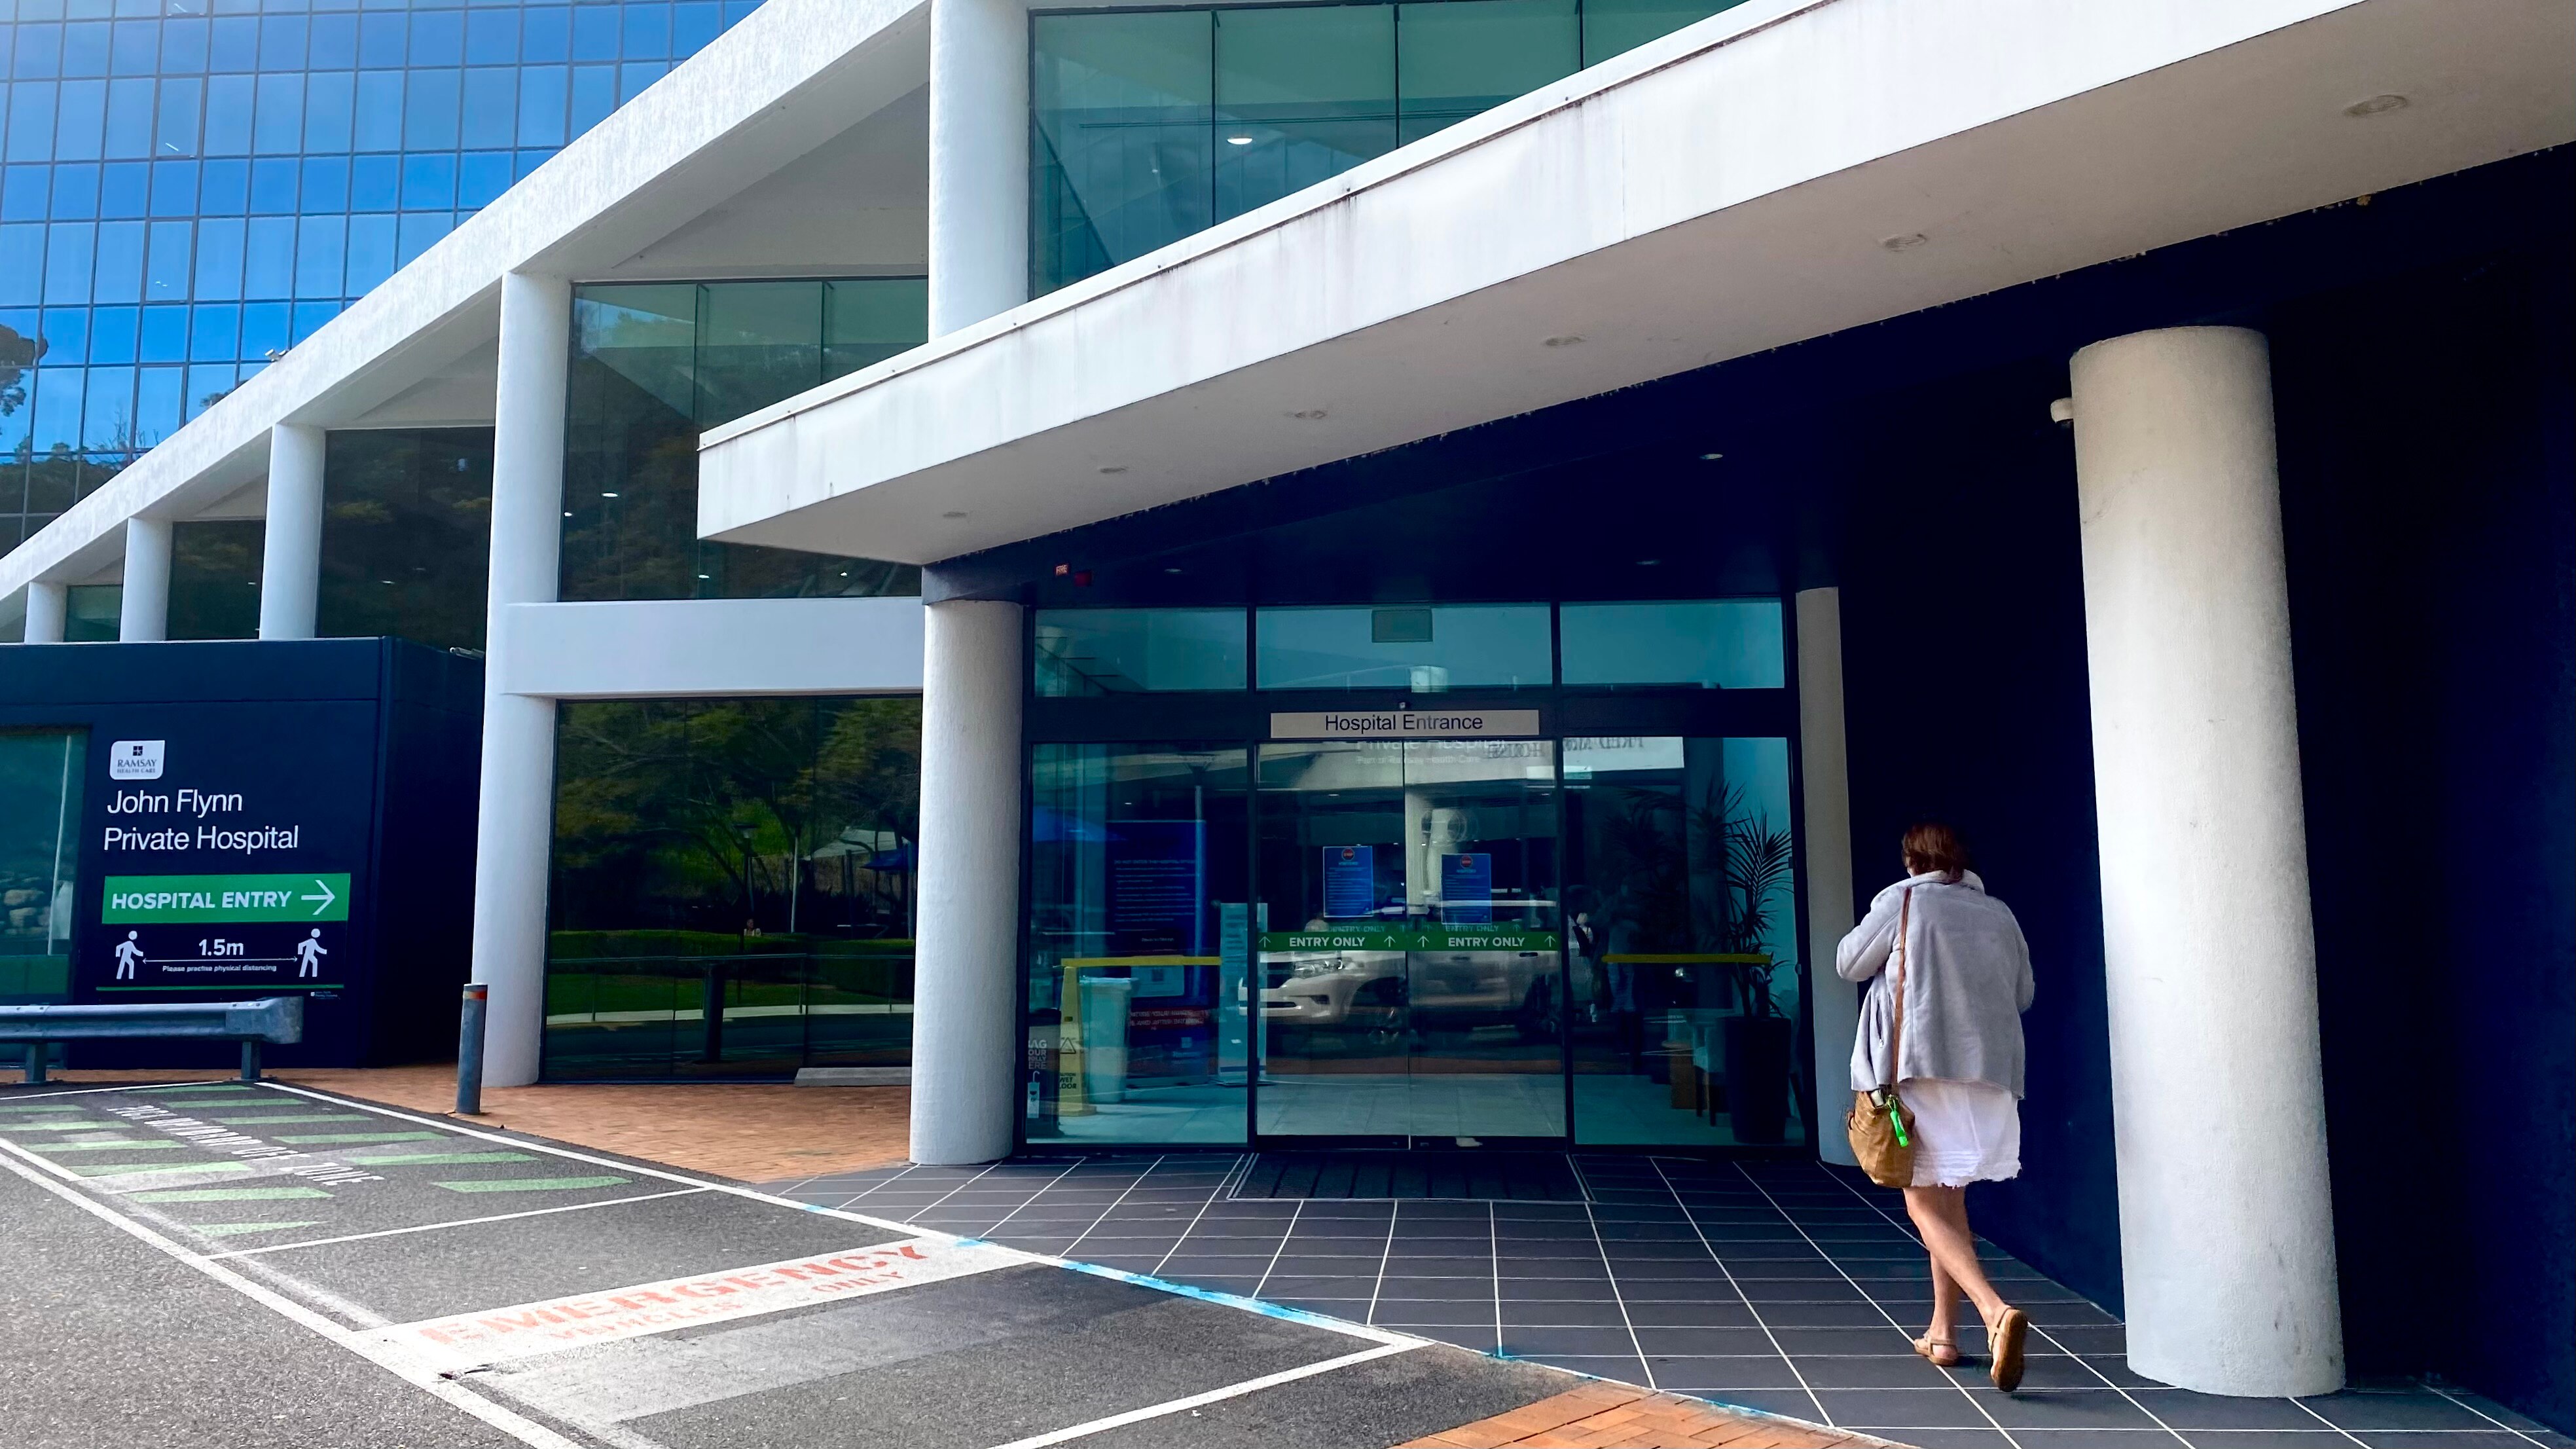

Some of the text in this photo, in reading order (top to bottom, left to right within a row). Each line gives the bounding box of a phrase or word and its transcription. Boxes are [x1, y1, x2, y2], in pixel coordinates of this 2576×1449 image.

[1326, 714, 1483, 734] Hospital Entrance
[118, 759, 157, 767] RAMSAY
[107, 789, 243, 818] John Flynn
[104, 825, 299, 854] Private Hospital
[111, 890, 292, 909] HOSPITAL ENTRY
[198, 938, 244, 956] 1.5m
[1289, 936, 1365, 947] ENTRY ONLY
[1448, 936, 1525, 947] ENTRY ONLY
[1028, 1040, 1047, 1048] AG
[230, 1146, 311, 1161] OFF
[278, 1162, 386, 1186] ZONE
[811, 1271, 904, 1293] ONLY
[419, 1245, 928, 1344] EMERGENCY
